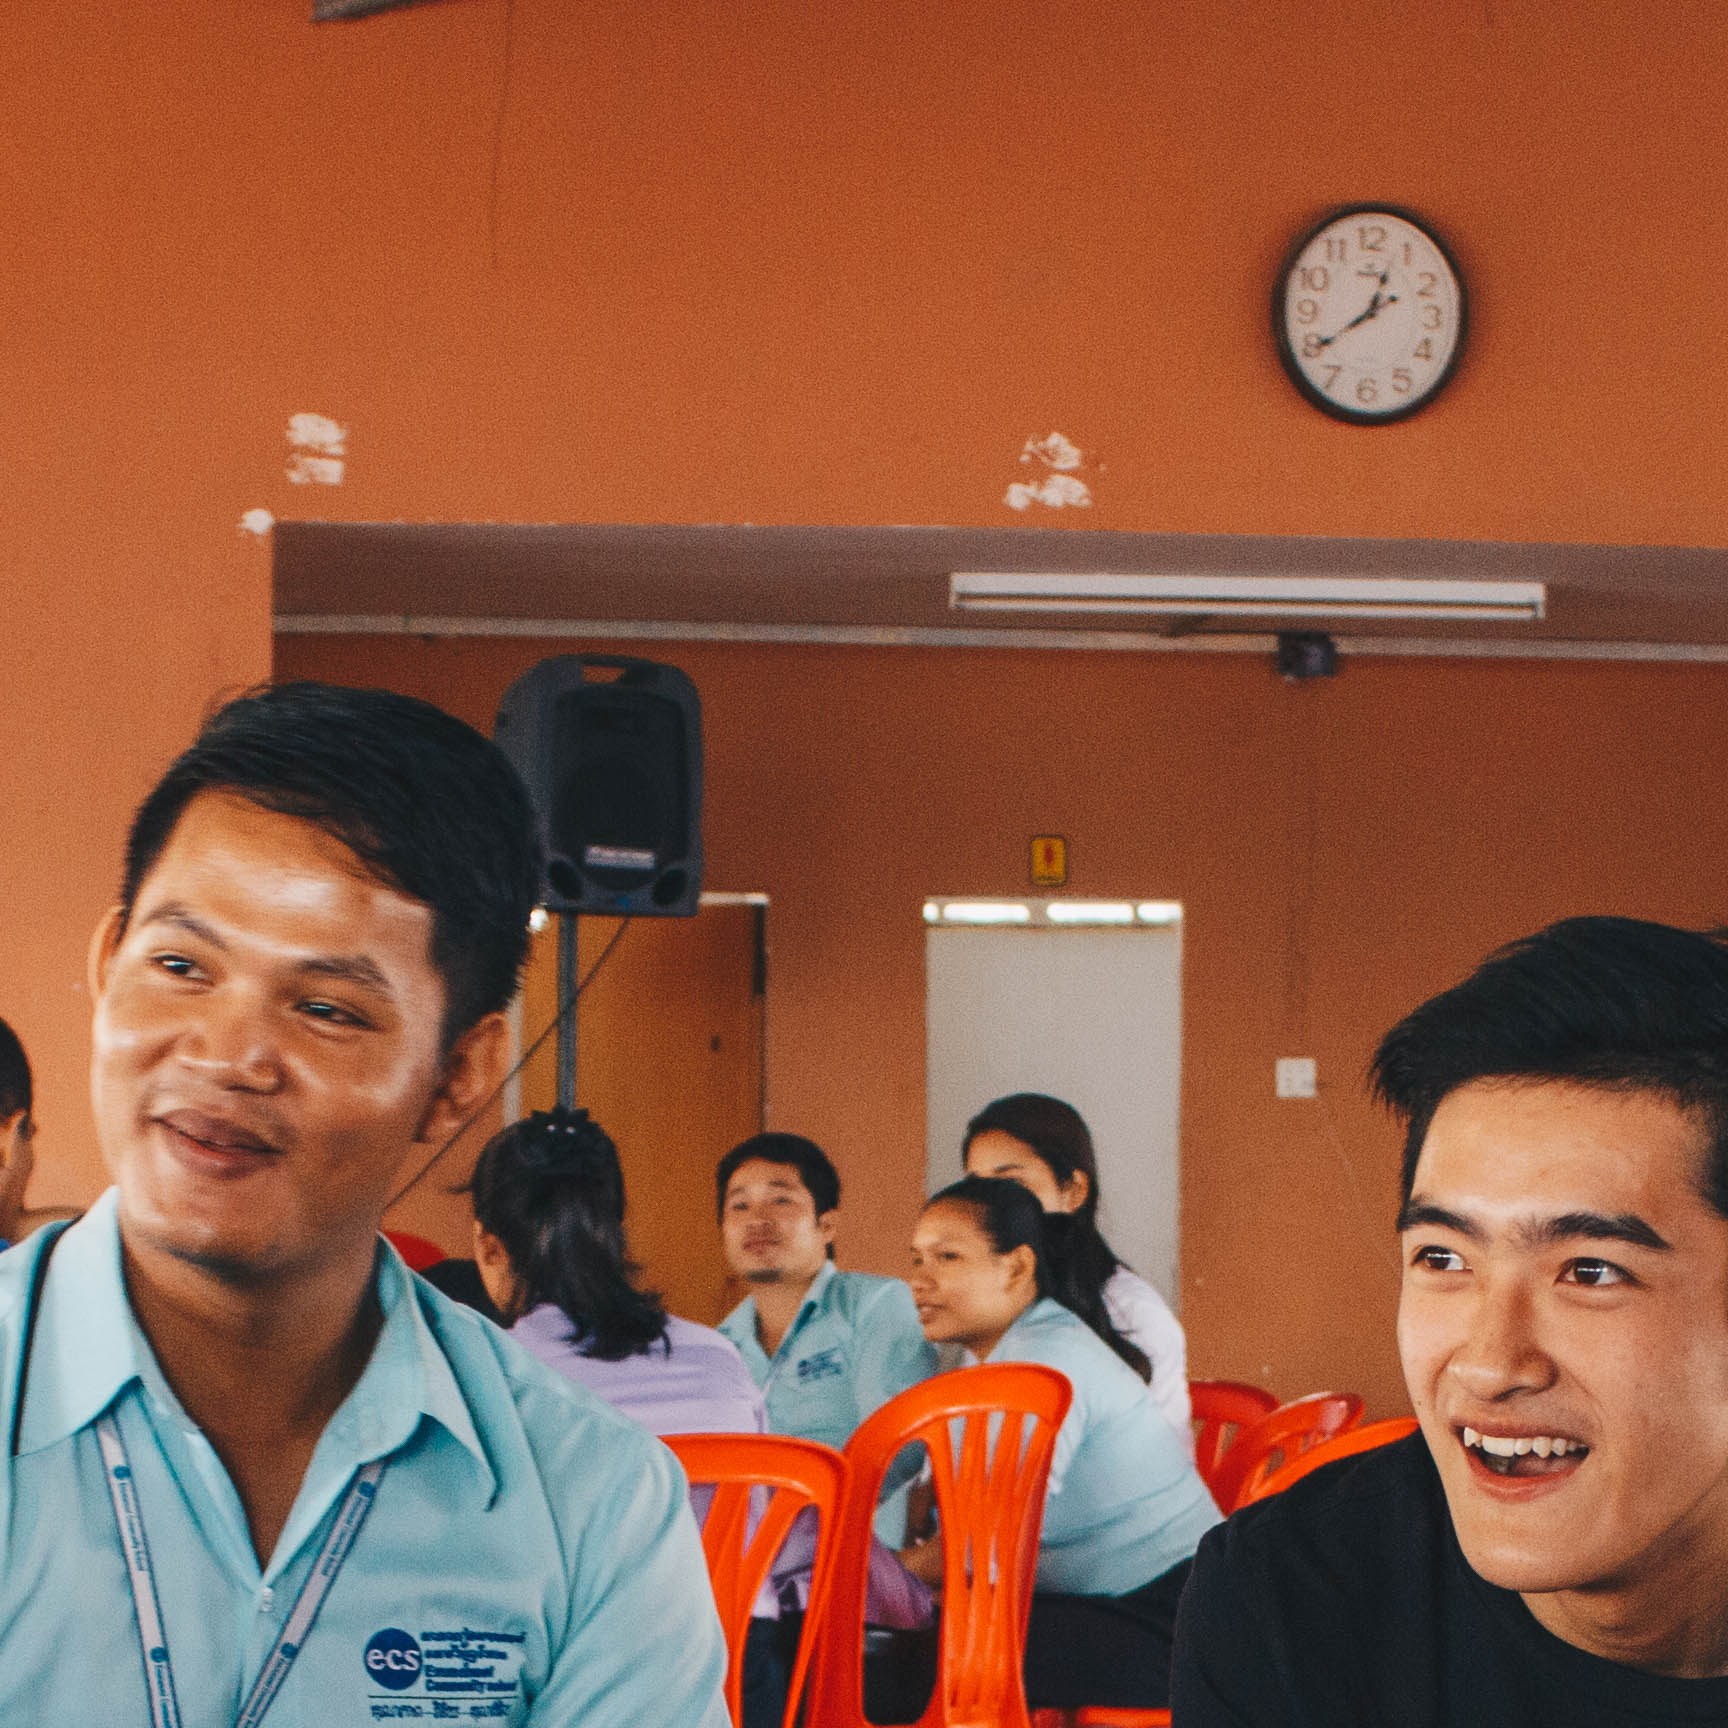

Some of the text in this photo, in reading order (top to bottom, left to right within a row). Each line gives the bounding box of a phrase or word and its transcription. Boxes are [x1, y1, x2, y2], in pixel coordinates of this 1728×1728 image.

[1324, 238, 1346, 264] 11
[1358, 226, 1387, 252] 12
[1404, 241, 1411, 267] 1
[1300, 265, 1329, 292] 10
[1417, 272, 1438, 298] 2
[1297, 299, 1318, 324] 9
[1422, 304, 1442, 330] 3
[1303, 333, 1324, 358] 8
[1414, 337, 1432, 361] 4
[1323, 365, 1343, 391] 7
[1356, 378, 1377, 403] 6
[1392, 368, 1412, 394] 5
[367, 1649, 421, 1671] ecs
